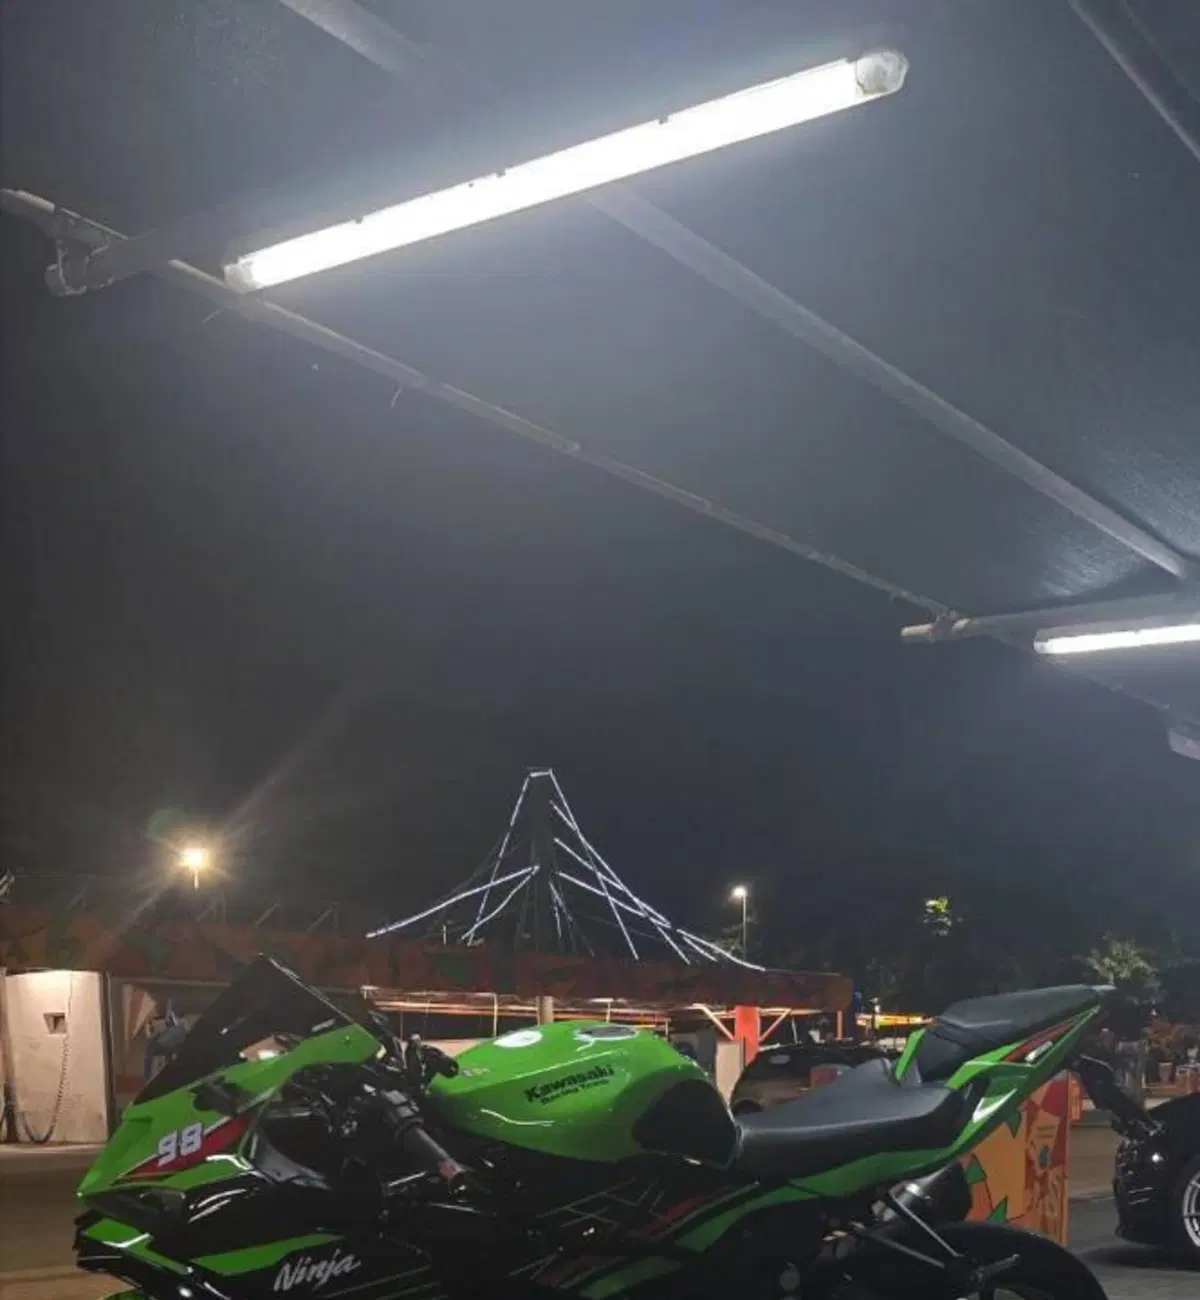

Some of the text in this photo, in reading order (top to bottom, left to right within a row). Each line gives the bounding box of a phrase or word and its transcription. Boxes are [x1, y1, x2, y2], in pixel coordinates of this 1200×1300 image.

[523, 1064, 615, 1102] Kawasaki
[158, 1122, 203, 1168] 98
[273, 1248, 362, 1293] Ninja
